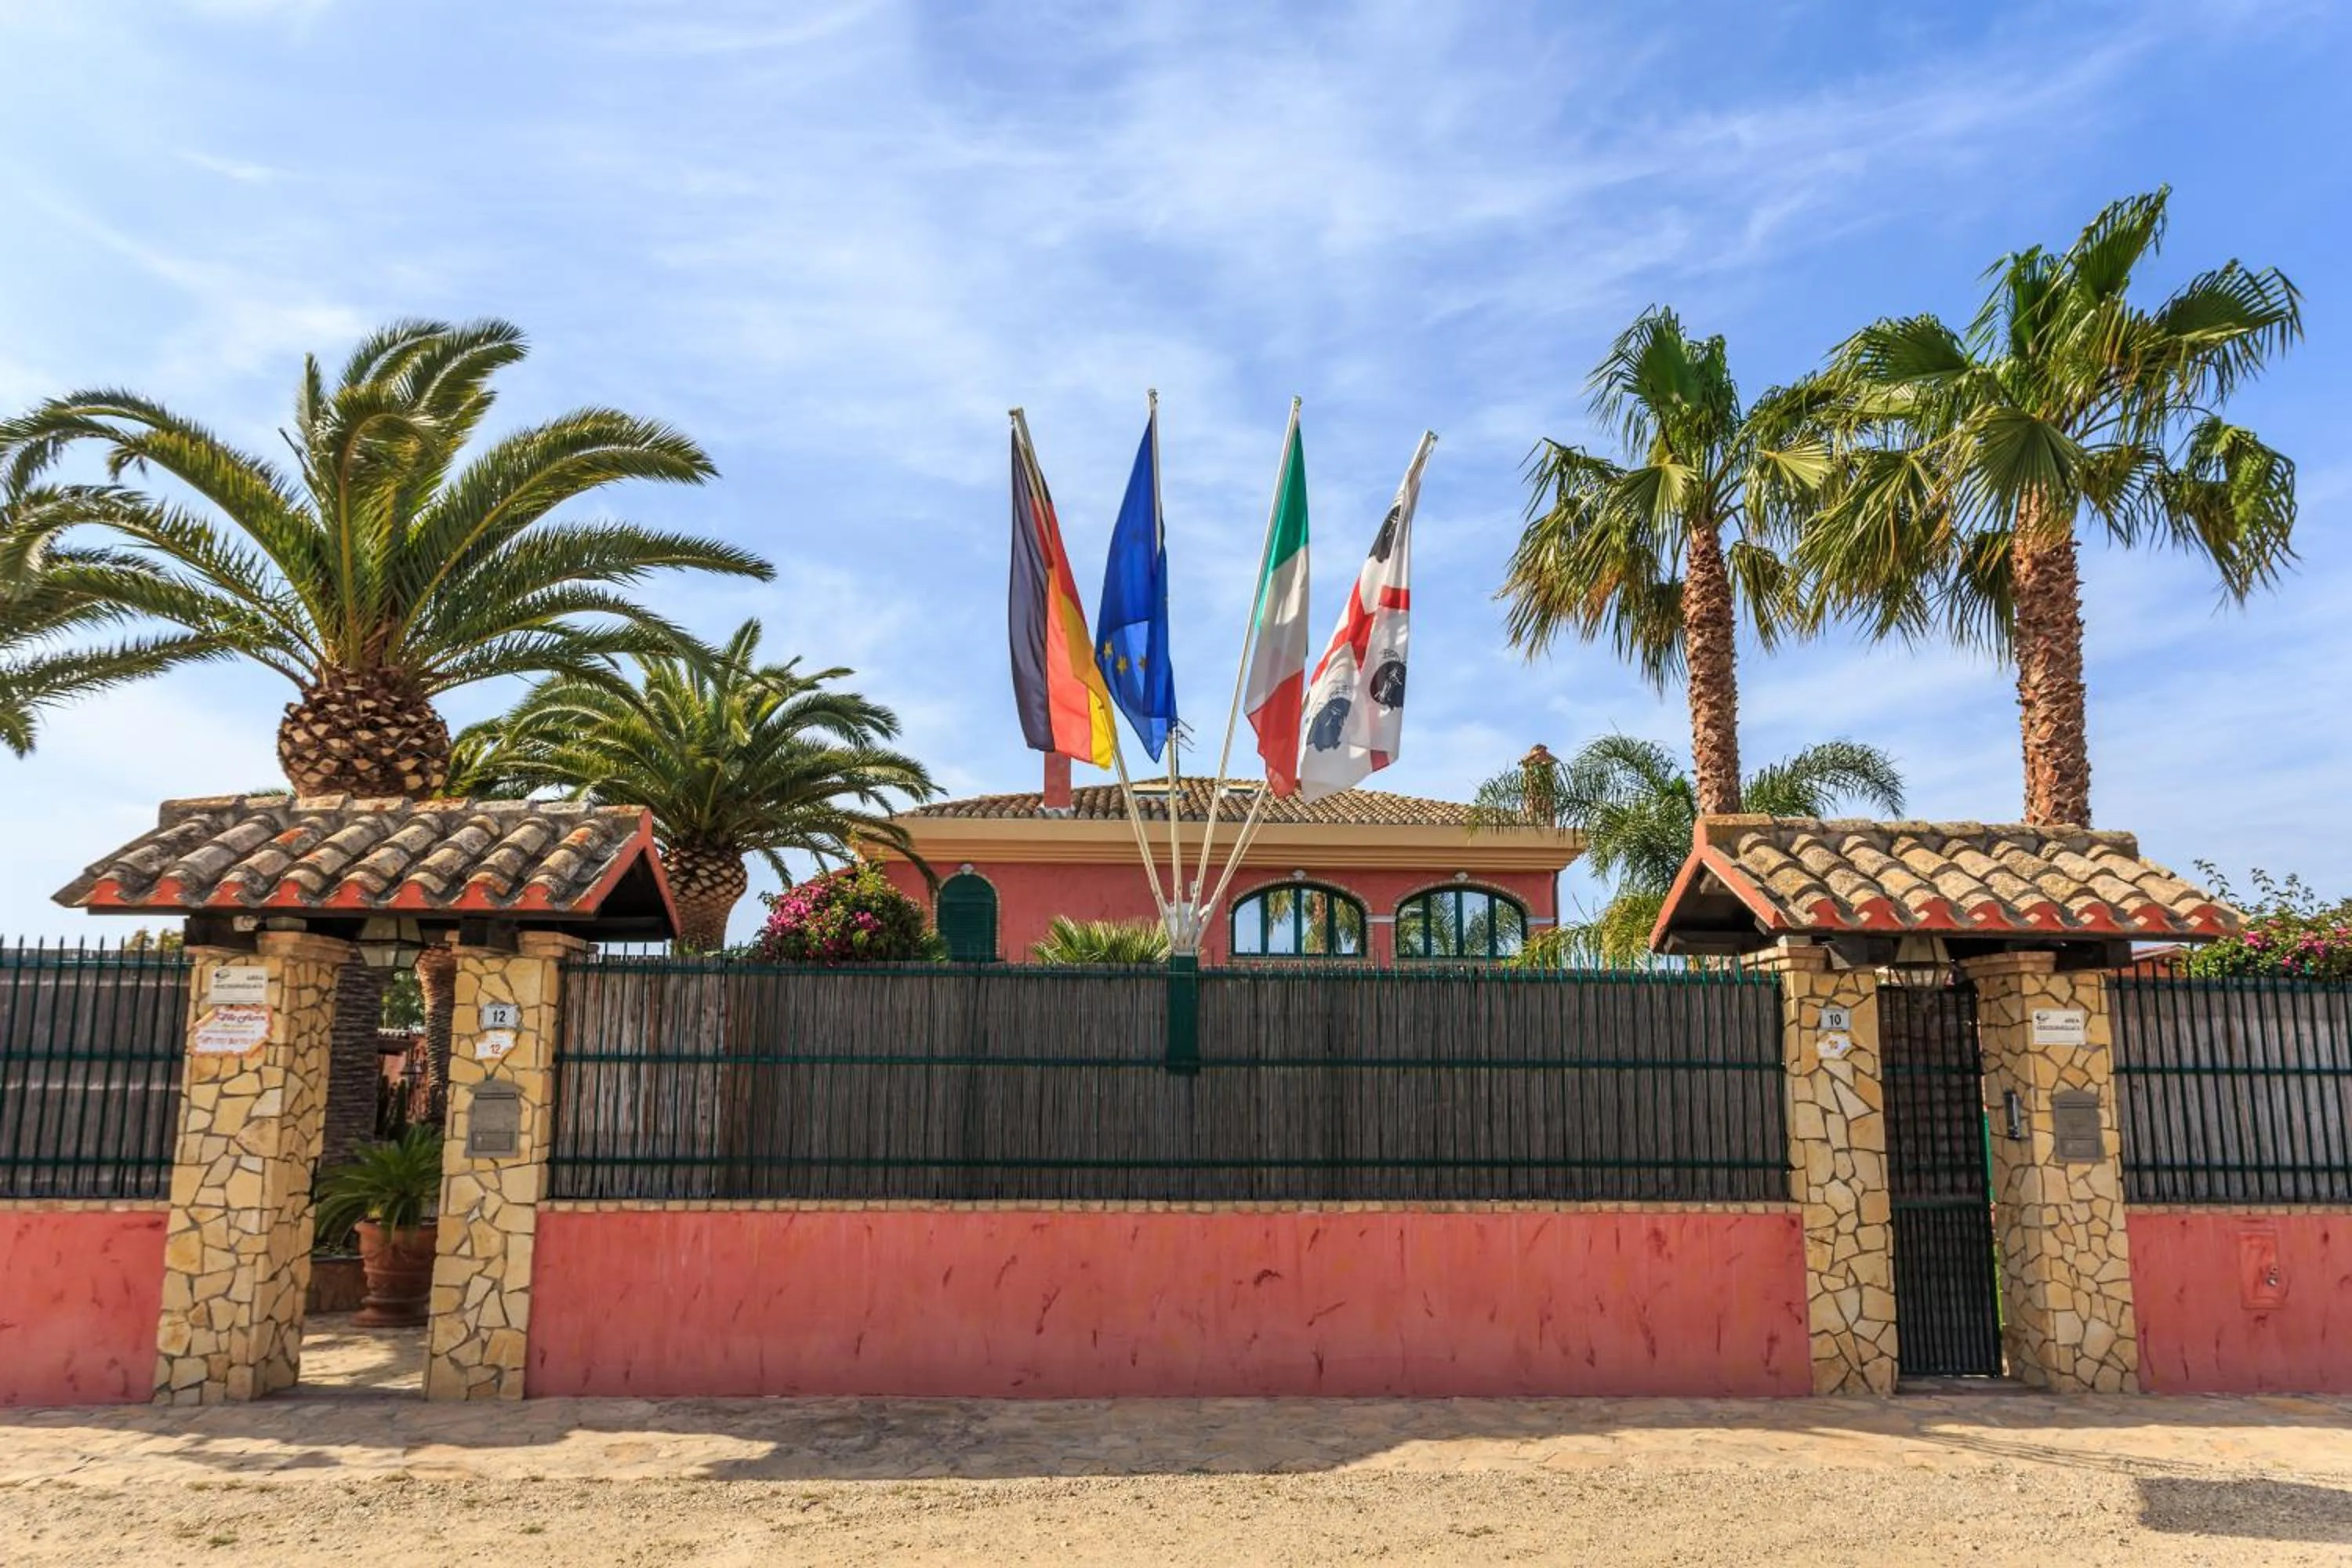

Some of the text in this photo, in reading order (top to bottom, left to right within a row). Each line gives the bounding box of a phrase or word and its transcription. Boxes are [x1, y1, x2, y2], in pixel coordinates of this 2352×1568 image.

[492, 1009, 506, 1023] 12
[1829, 1014, 1842, 1026] 10
[490, 1044, 501, 1054] 12
